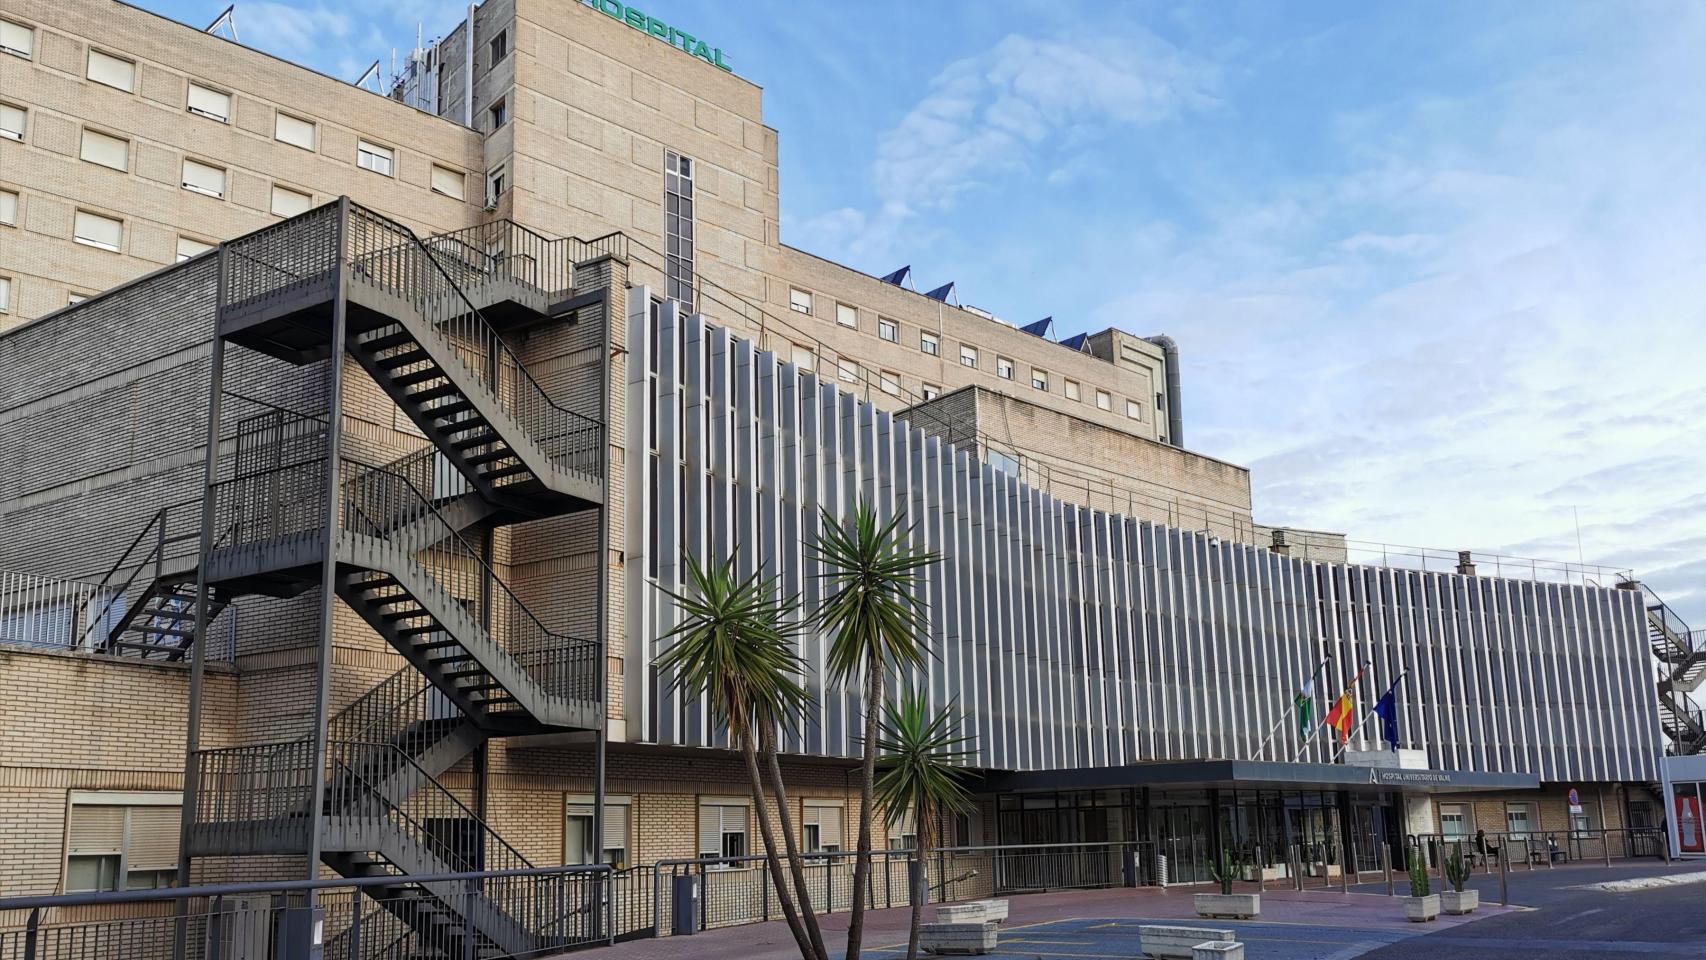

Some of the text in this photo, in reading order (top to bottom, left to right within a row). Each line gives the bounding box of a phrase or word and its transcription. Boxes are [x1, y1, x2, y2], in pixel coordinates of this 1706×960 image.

[1382, 772, 1402, 780] HOSPITAL
[1403, 773, 1433, 781] UNIVERSITARIO
[1433, 774, 1438, 782] DE
